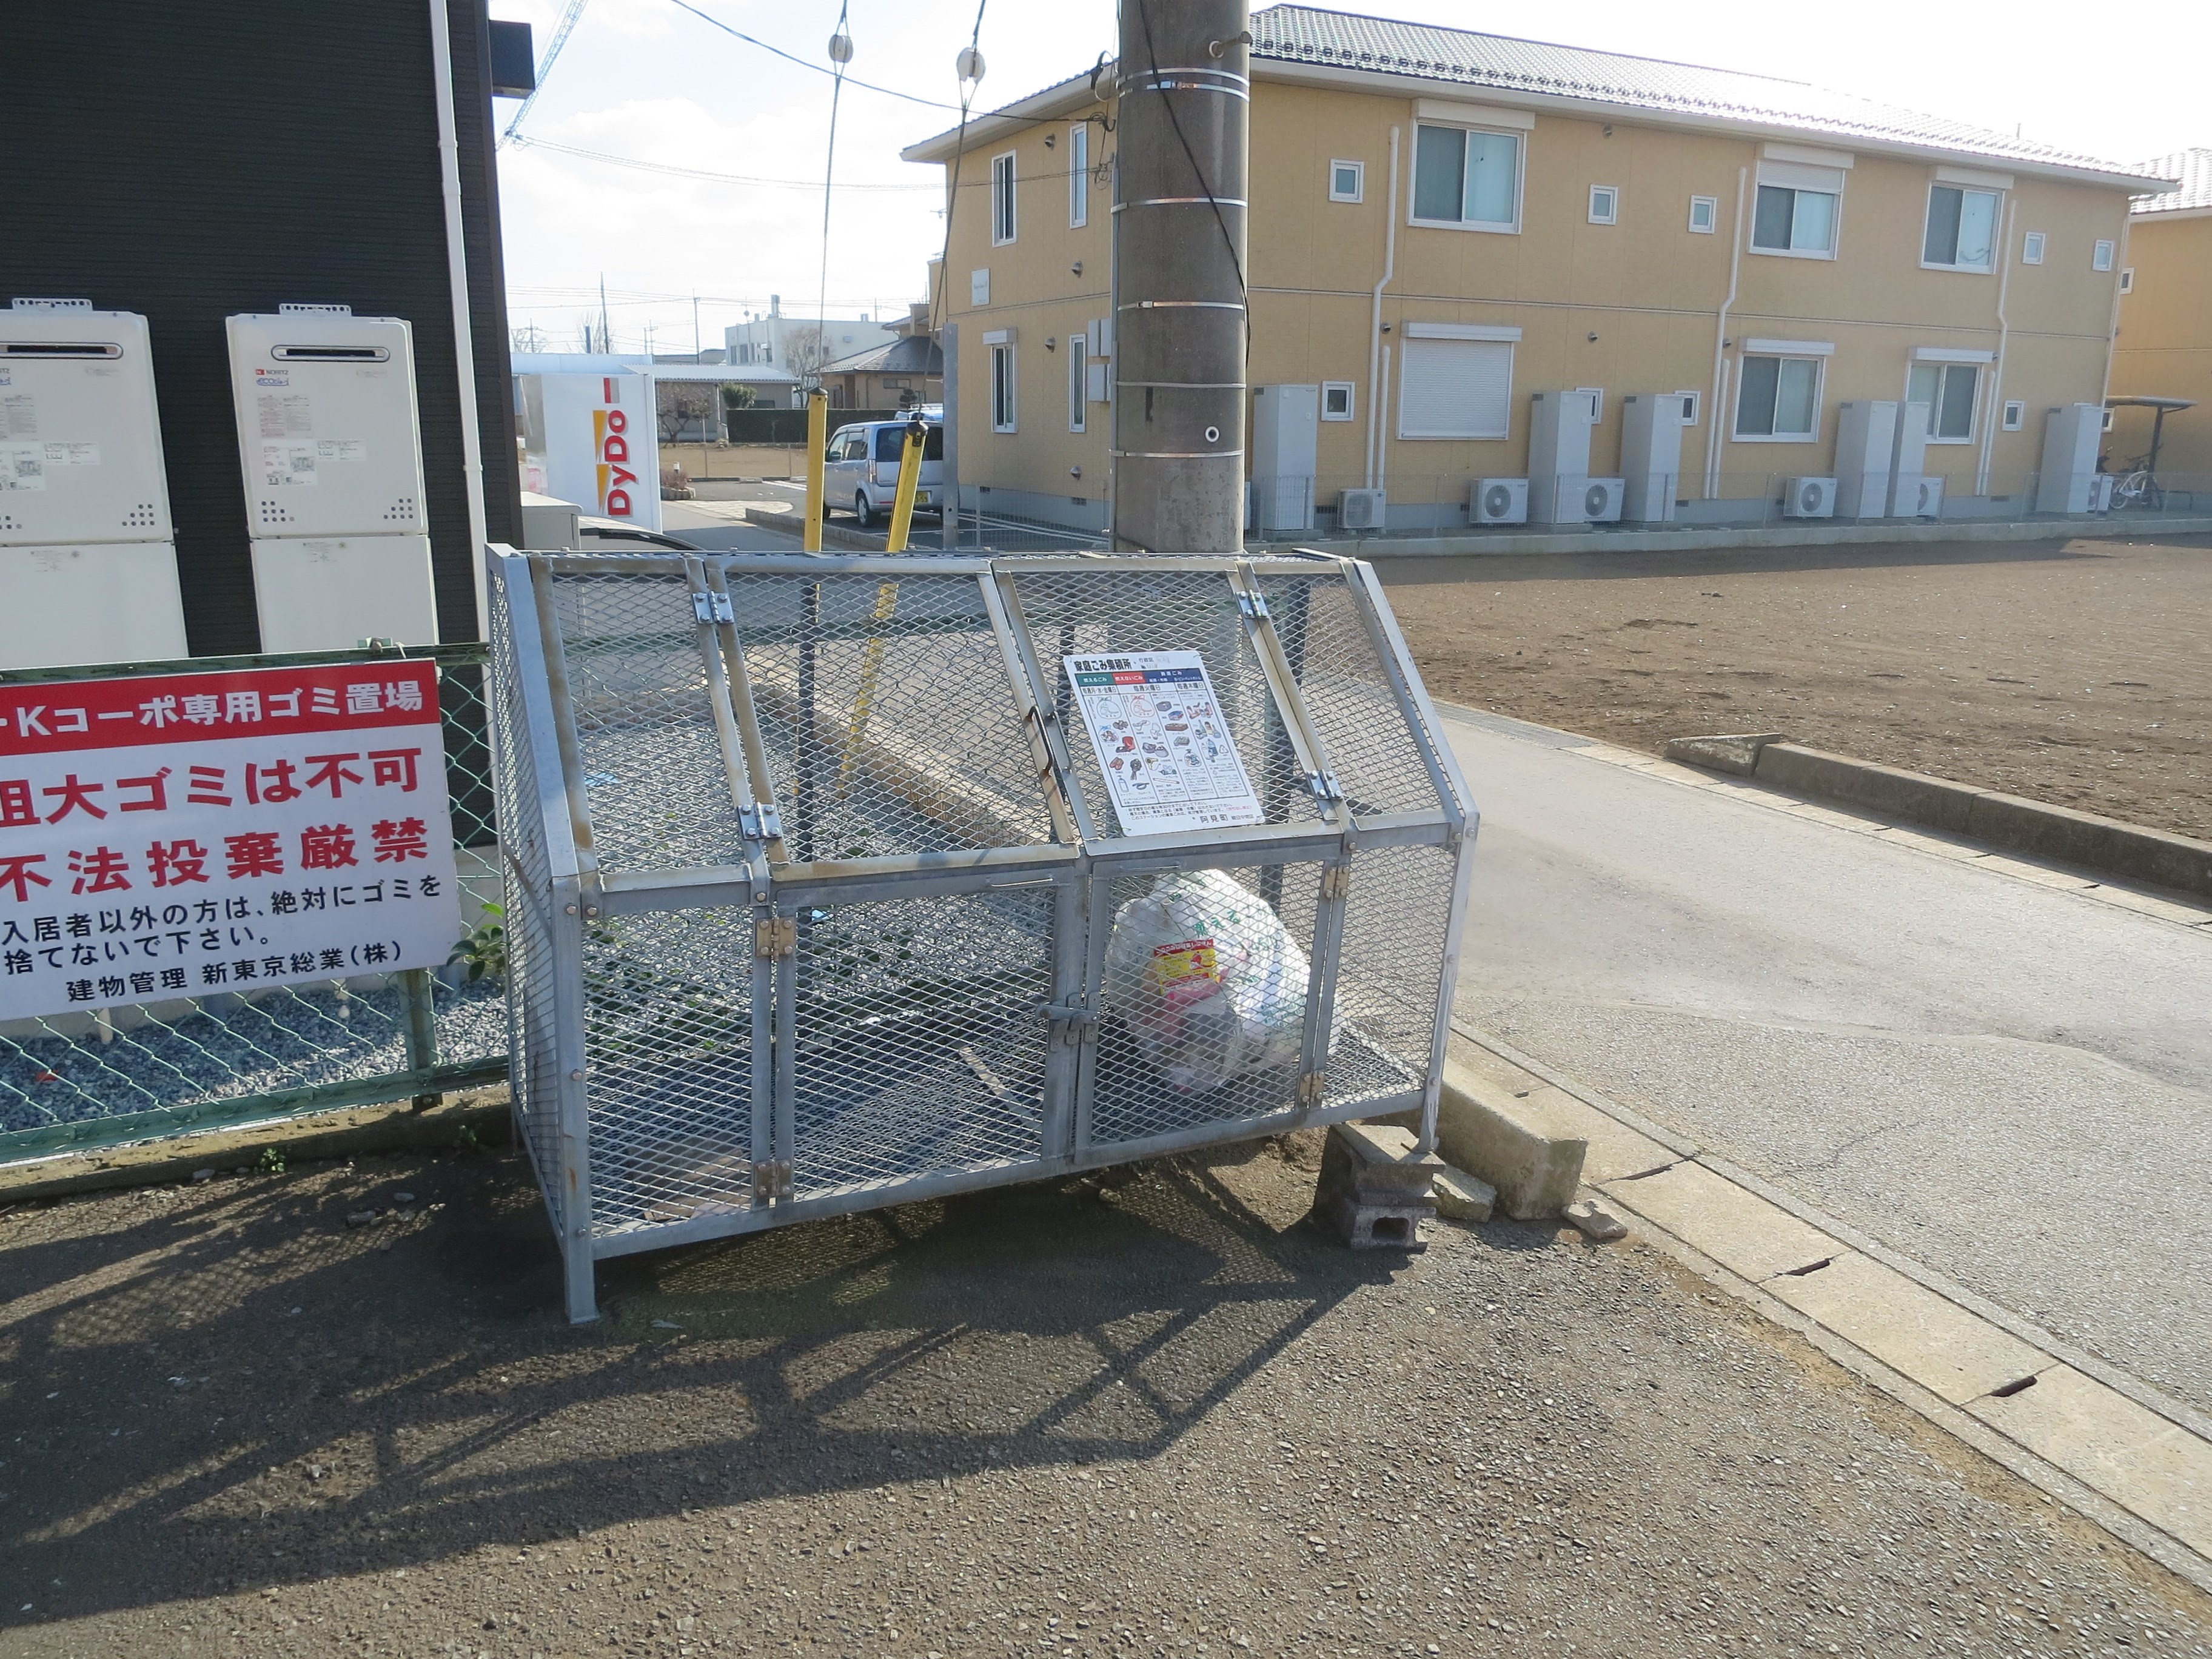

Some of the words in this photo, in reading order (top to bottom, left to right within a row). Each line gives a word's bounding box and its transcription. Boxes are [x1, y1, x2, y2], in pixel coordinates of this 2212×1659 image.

[604, 410, 639, 517] DyDo
[0, 817, 429, 902] 不法投棄厳禁
[2, 874, 441, 945] 入居者以外の方は、絶対にゴミを
[4, 925, 270, 975] 捨てないで下さい。
[66, 967, 188, 1003] 建物管理
[203, 940, 401, 985] 新東京総業(株)
